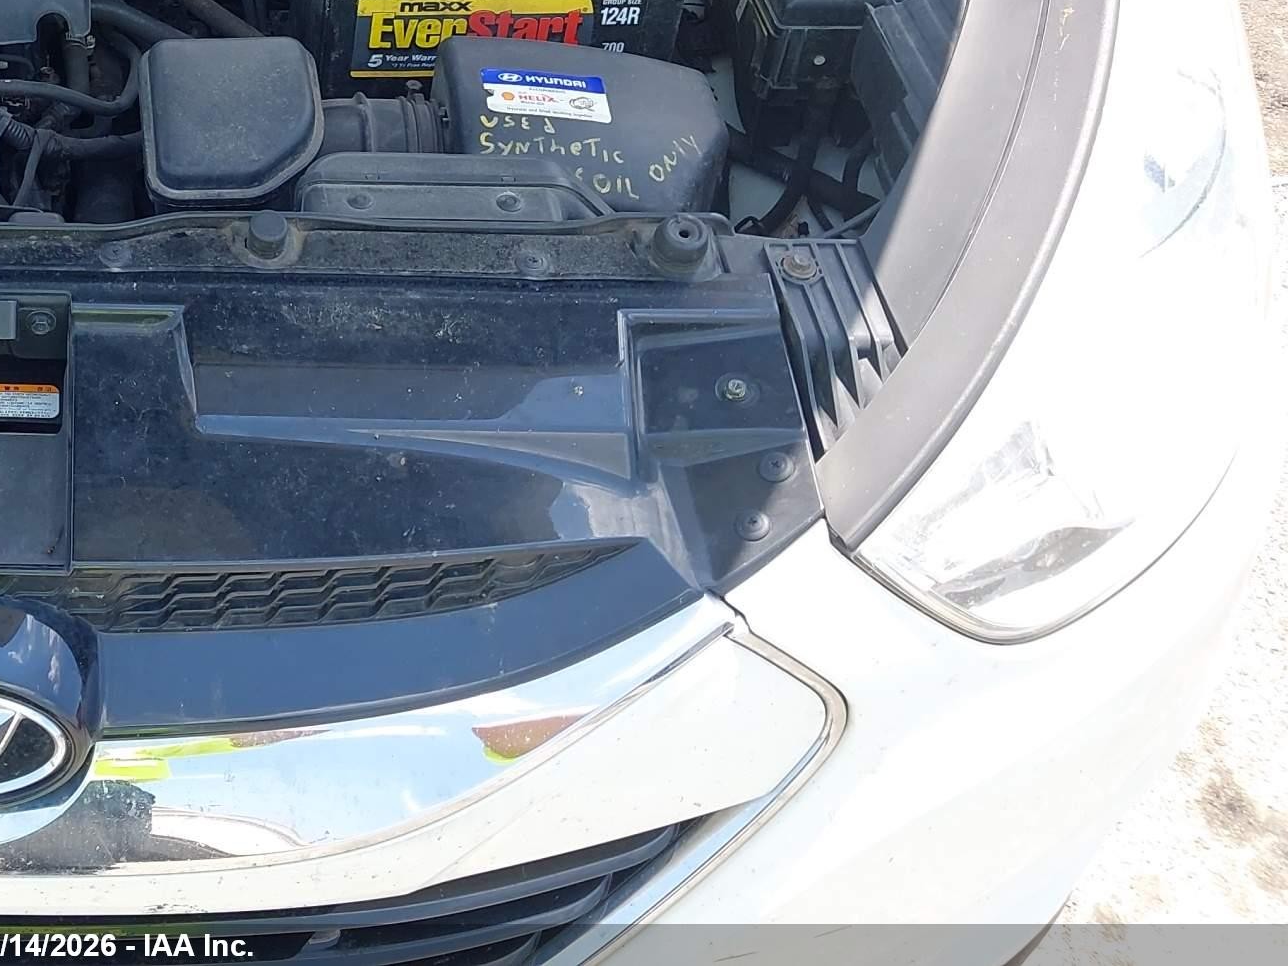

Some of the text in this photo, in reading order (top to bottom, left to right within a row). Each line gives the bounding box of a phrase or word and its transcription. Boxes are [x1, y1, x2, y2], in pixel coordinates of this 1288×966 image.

[400, 1, 472, 13] maxx
[600, 6, 641, 26] 124R
[368, 8, 584, 49] EverStart
[367, 54, 383, 68] 5
[385, 54, 410, 62] Year
[524, 74, 587, 89] HYUNDAI
[518, 94, 560, 104] HELIX
